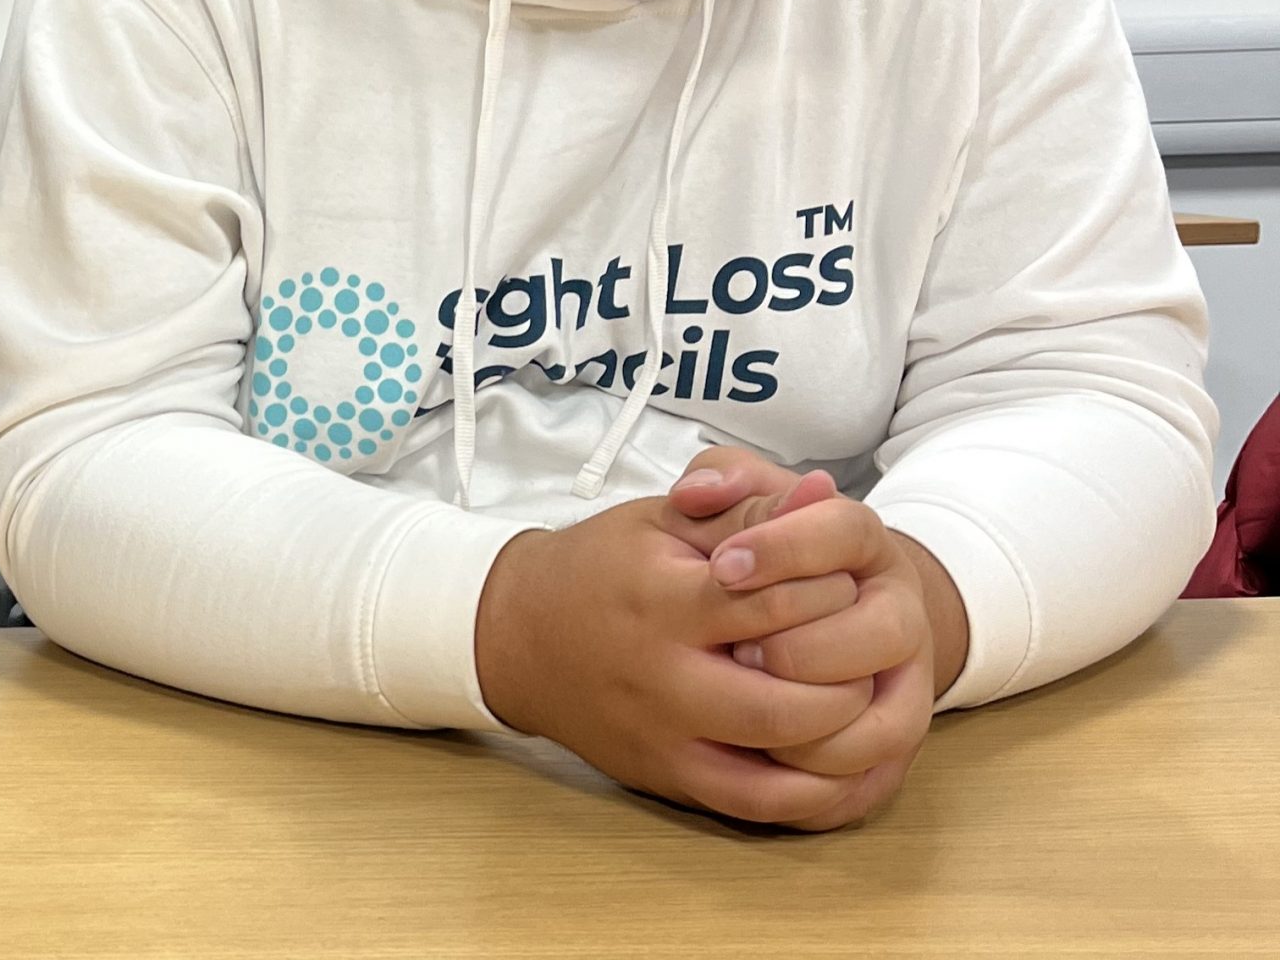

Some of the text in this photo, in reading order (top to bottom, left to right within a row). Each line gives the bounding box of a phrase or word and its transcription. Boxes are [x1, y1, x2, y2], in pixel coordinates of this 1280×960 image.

[796, 200, 854, 239] TM
[436, 243, 854, 354] ght Loss
